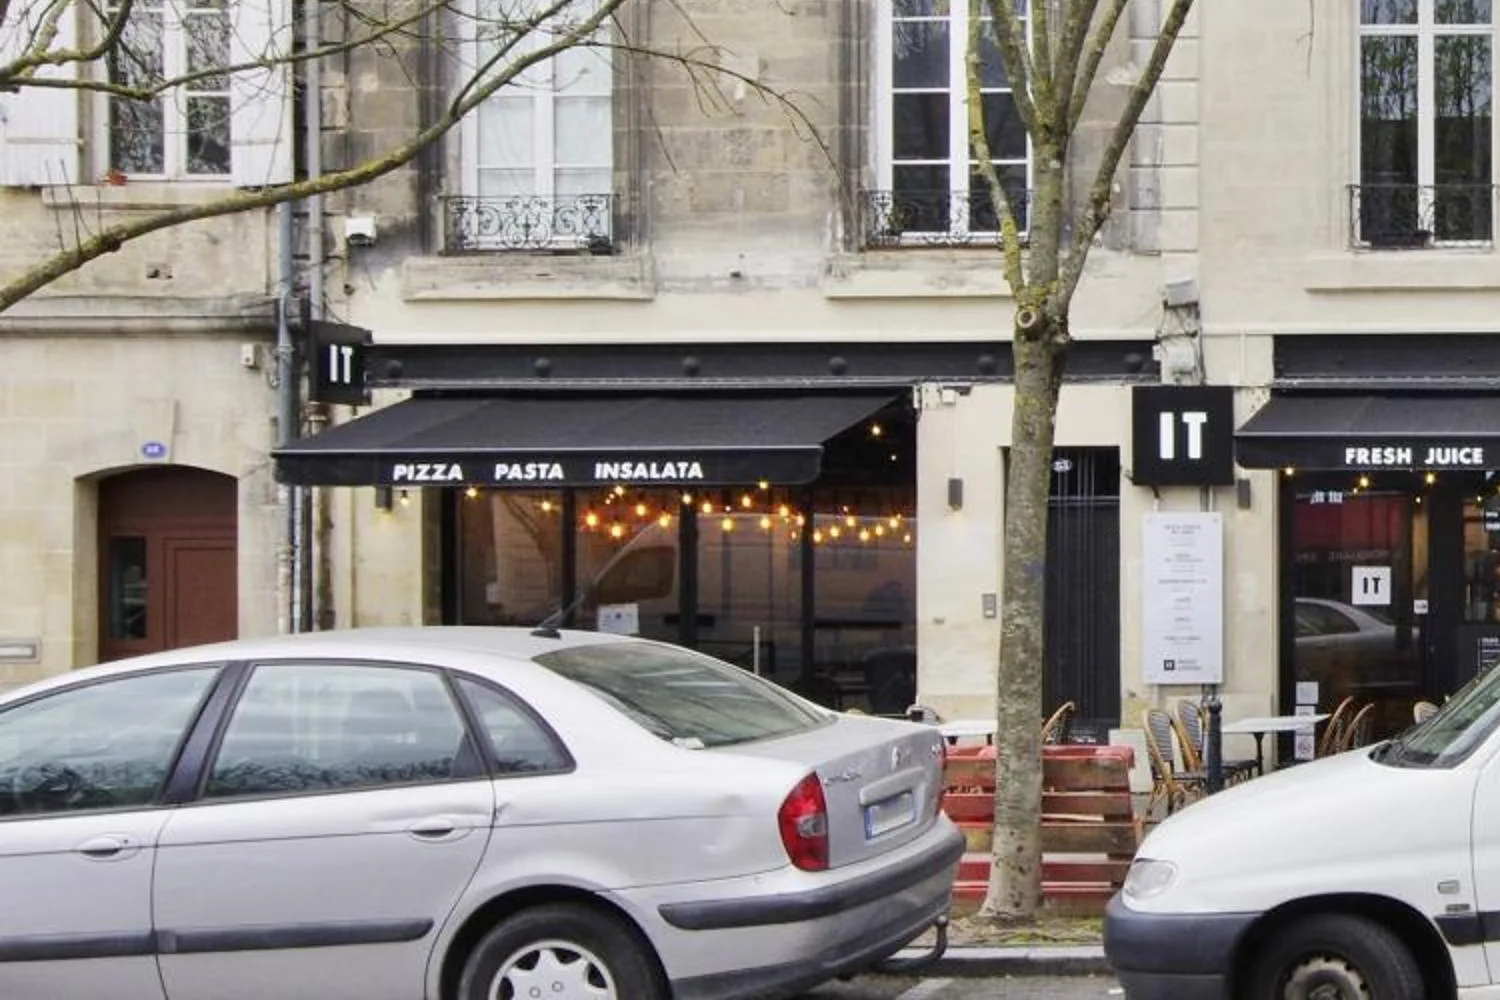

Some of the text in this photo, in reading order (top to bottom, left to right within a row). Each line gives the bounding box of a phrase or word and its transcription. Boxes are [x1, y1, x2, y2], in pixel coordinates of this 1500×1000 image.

[329, 343, 353, 384] IT
[1159, 411, 1208, 460] IT
[1345, 447, 1412, 465] FRESH
[1424, 447, 1484, 465] JUICE
[392, 461, 704, 482] PIZZA PASTA INSALATA
[1363, 577, 1381, 595] IT
